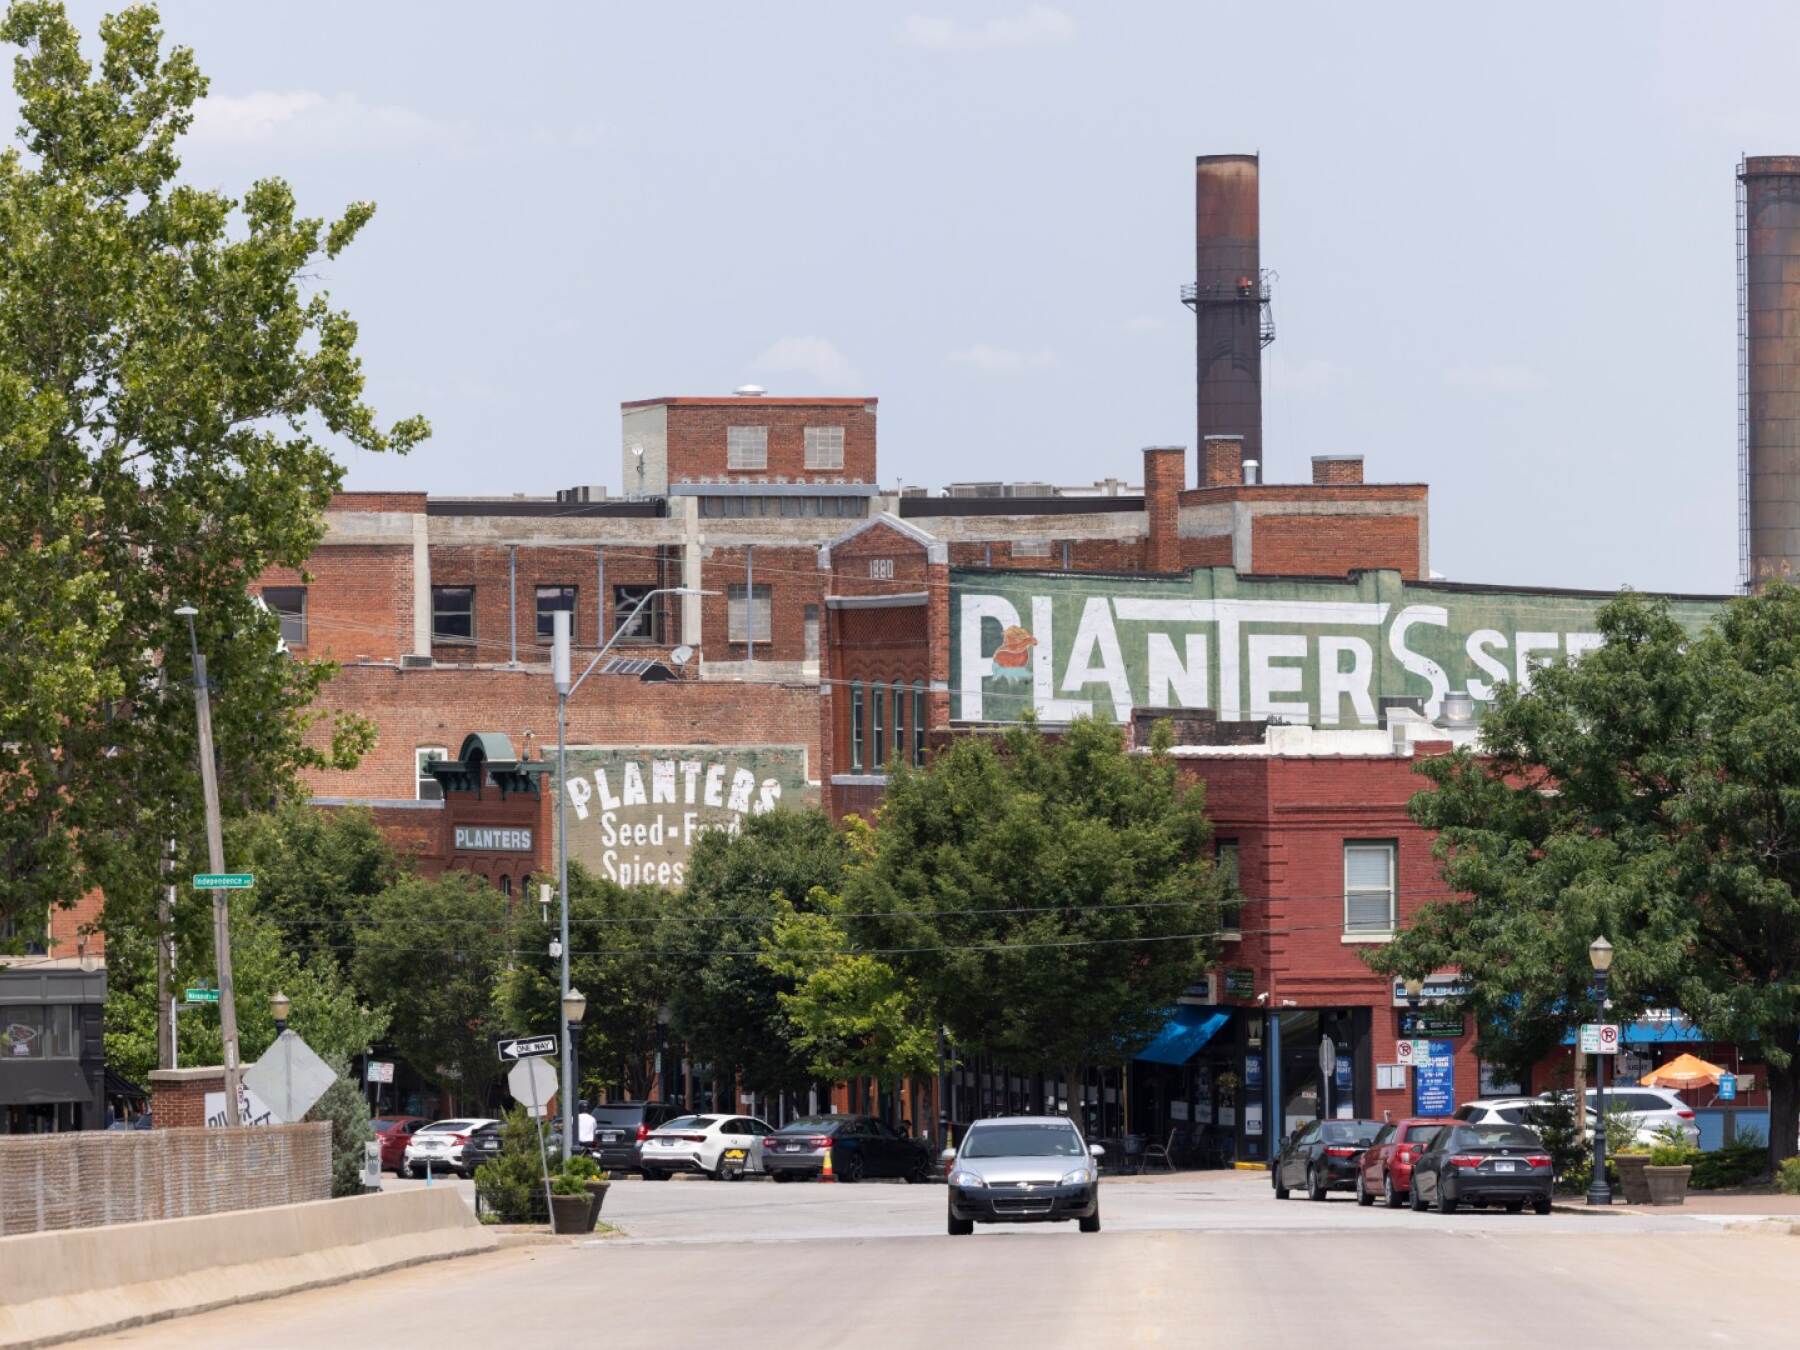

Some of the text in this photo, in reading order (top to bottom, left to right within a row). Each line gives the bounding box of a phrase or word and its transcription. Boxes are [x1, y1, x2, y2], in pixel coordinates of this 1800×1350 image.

[959, 594, 1606, 725] PLANTERS SE
[566, 760, 782, 820] PLANTERS
[455, 829, 531, 849] PLANTERS
[601, 850, 685, 890] Spices
[516, 1041, 550, 1053] ONE WAY
